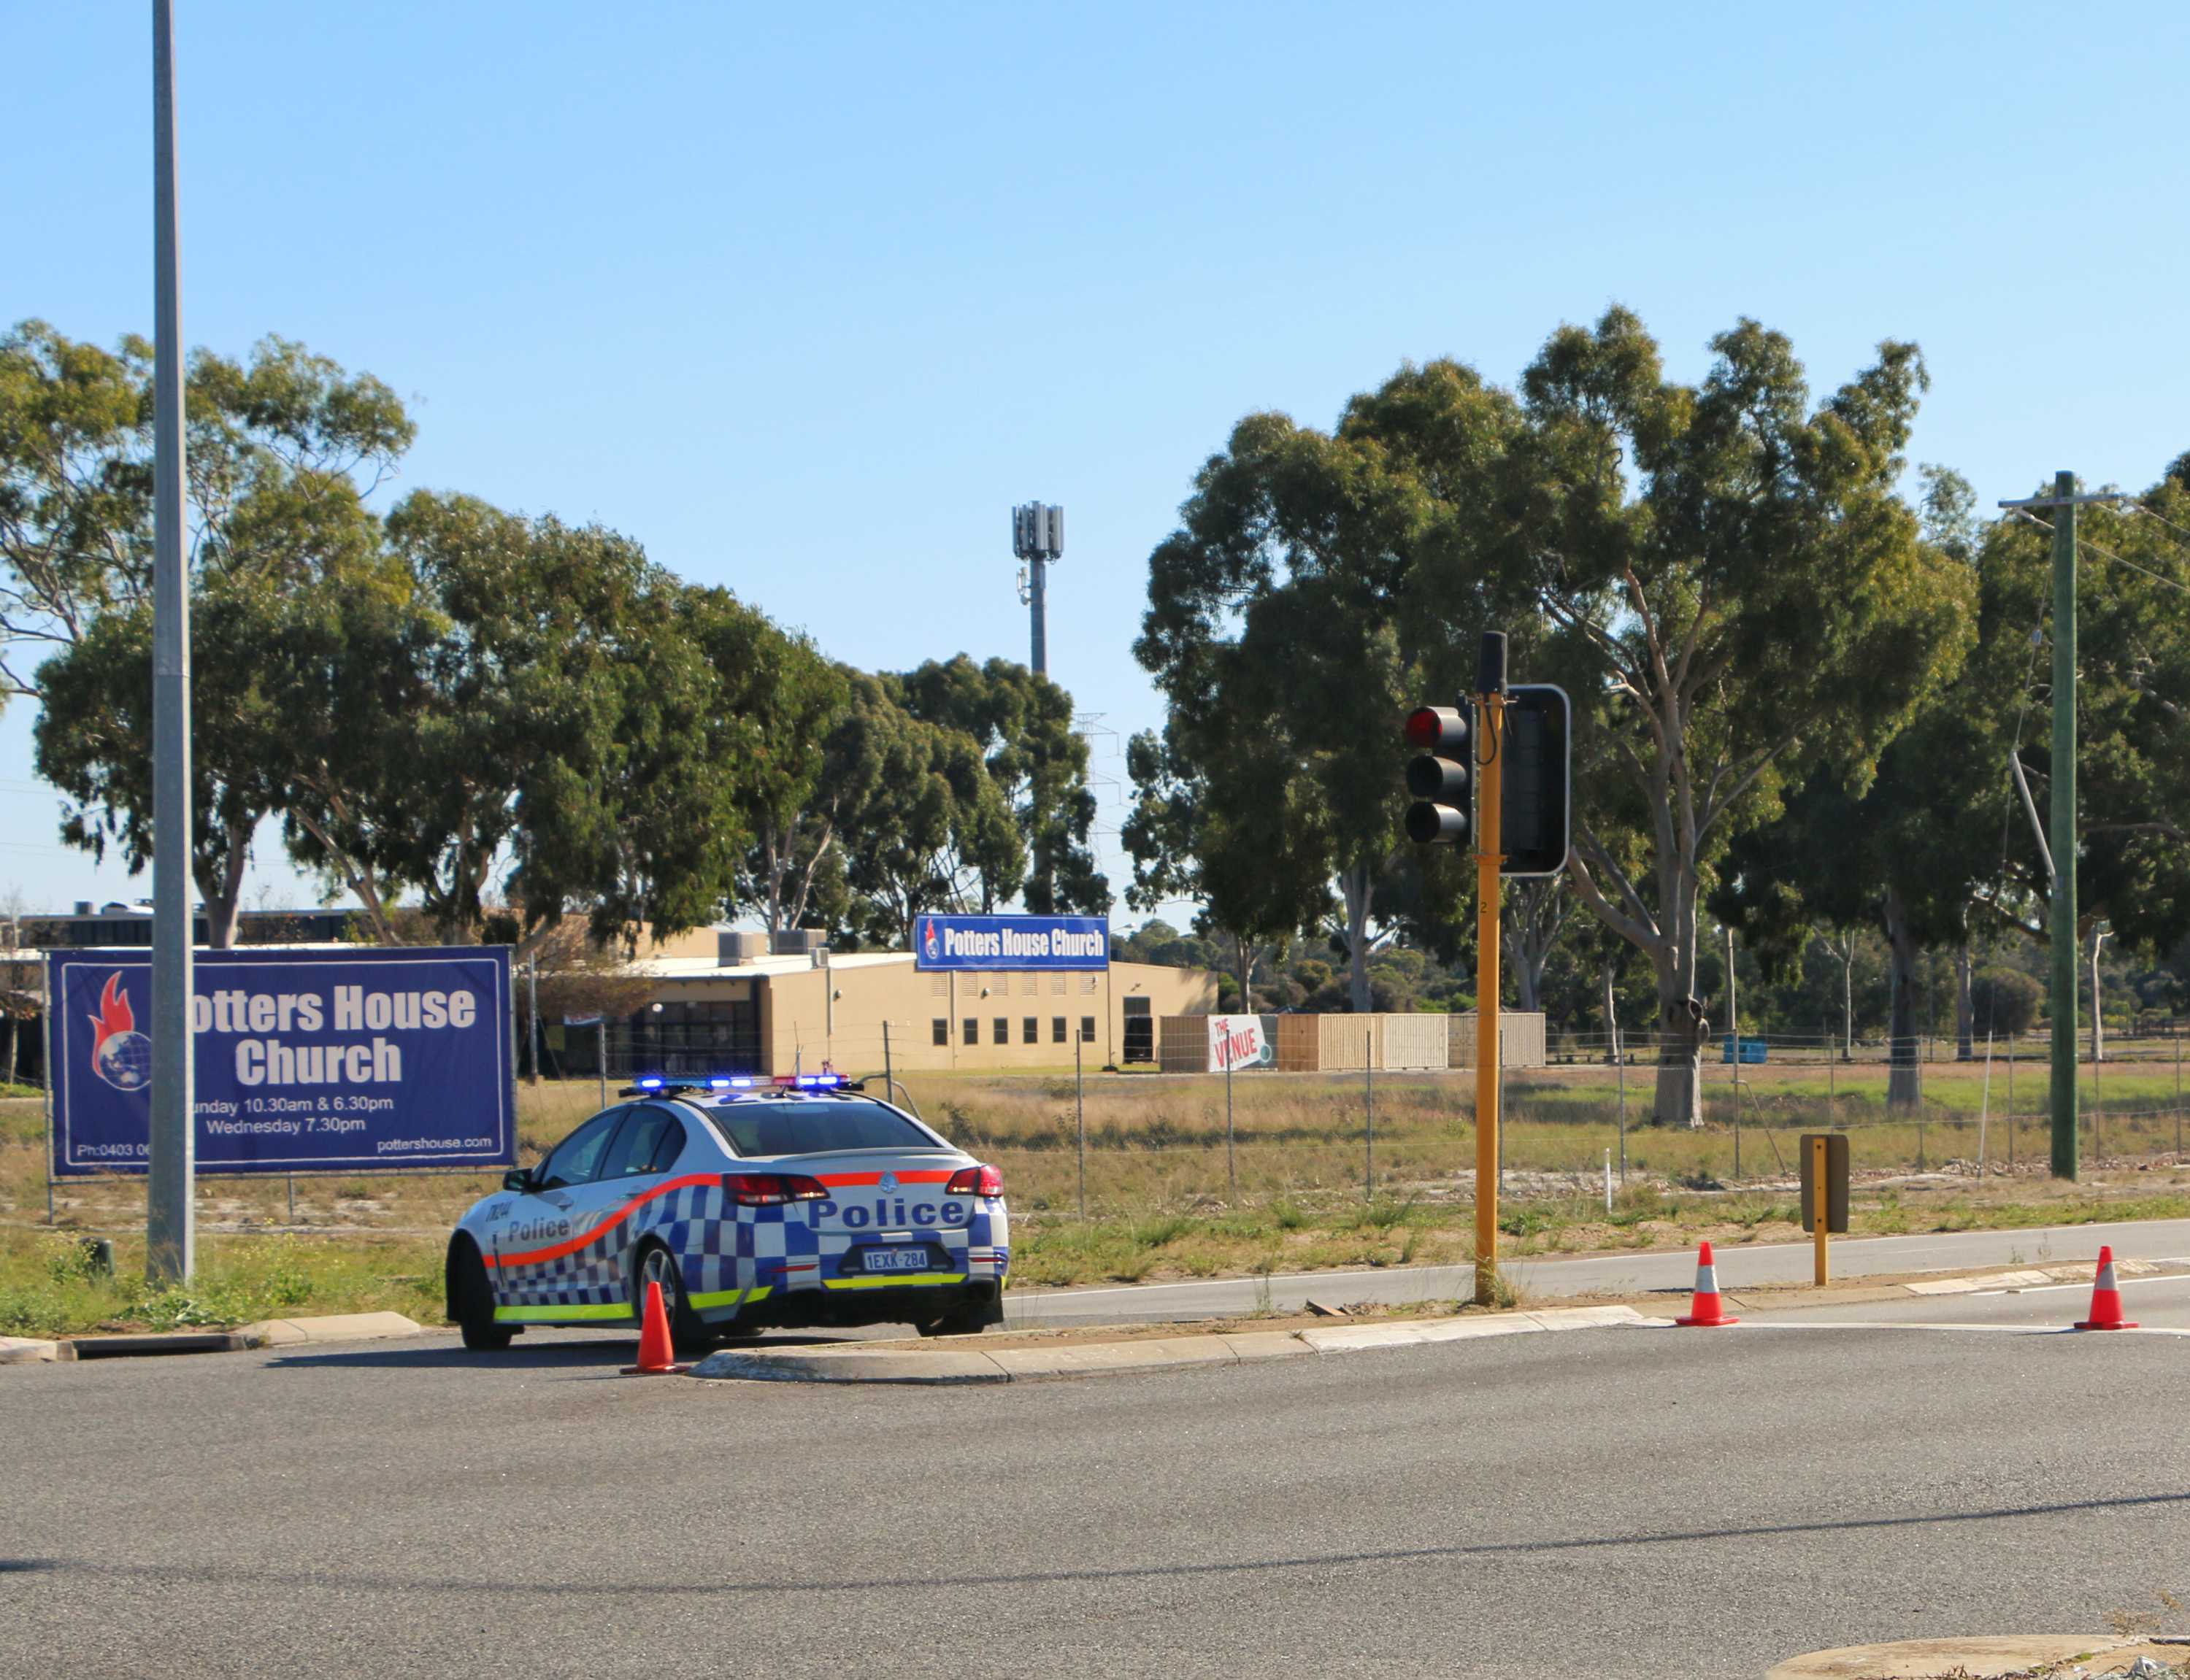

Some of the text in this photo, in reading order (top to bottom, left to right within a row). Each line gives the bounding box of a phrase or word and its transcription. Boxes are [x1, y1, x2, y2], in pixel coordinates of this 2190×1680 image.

[945, 928, 1104, 957] Potters House Church
[193, 985, 475, 1033] otters House
[1214, 1018, 1229, 1037] THE
[236, 1038, 401, 1085] Church
[194, 1096, 393, 1117] unday 10.30am & 6.30pm
[206, 1117, 366, 1136] Wednesday 7.30pm
[377, 1136, 491, 1155] pottershouse.com
[808, 1198, 964, 1228] Police
[507, 1217, 569, 1242] Police
